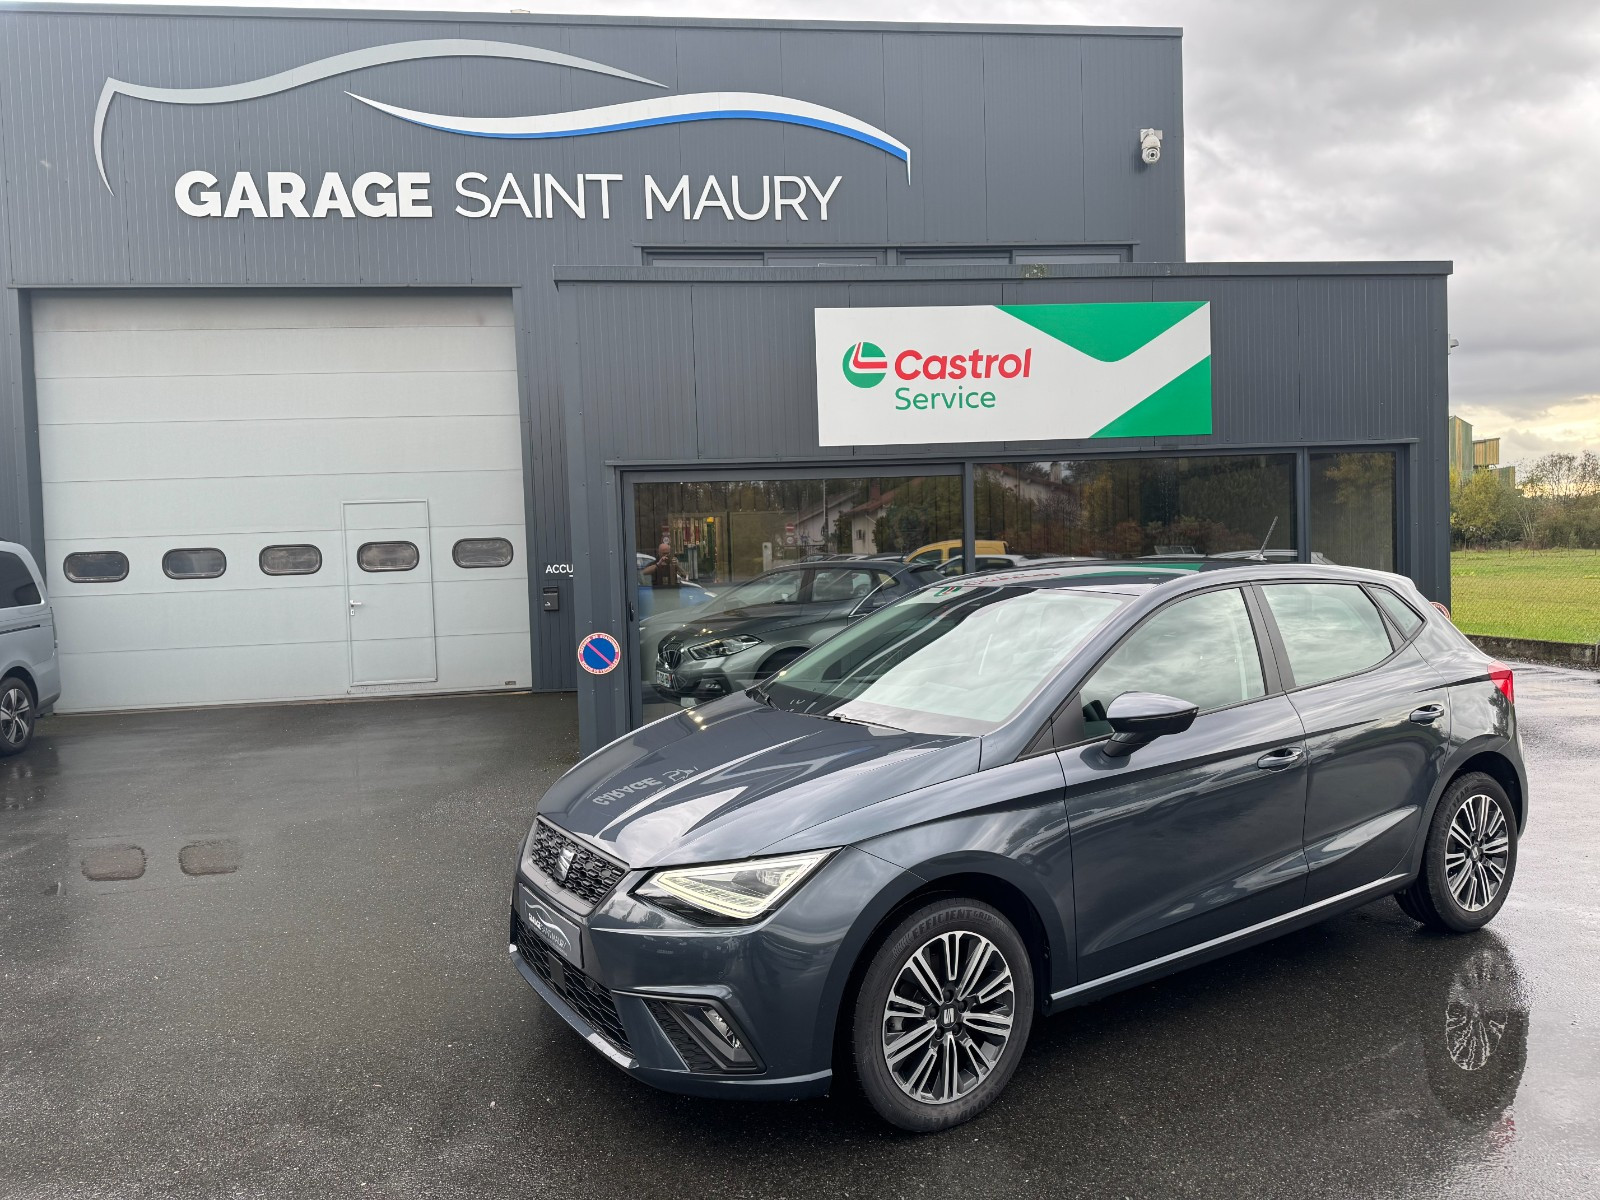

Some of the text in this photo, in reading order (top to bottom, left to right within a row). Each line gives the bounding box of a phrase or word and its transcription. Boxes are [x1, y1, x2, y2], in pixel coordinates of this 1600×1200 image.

[174, 170, 843, 221] GARAGE SAINT MAURY
[895, 348, 1032, 381] Castrol
[895, 385, 996, 411] Service
